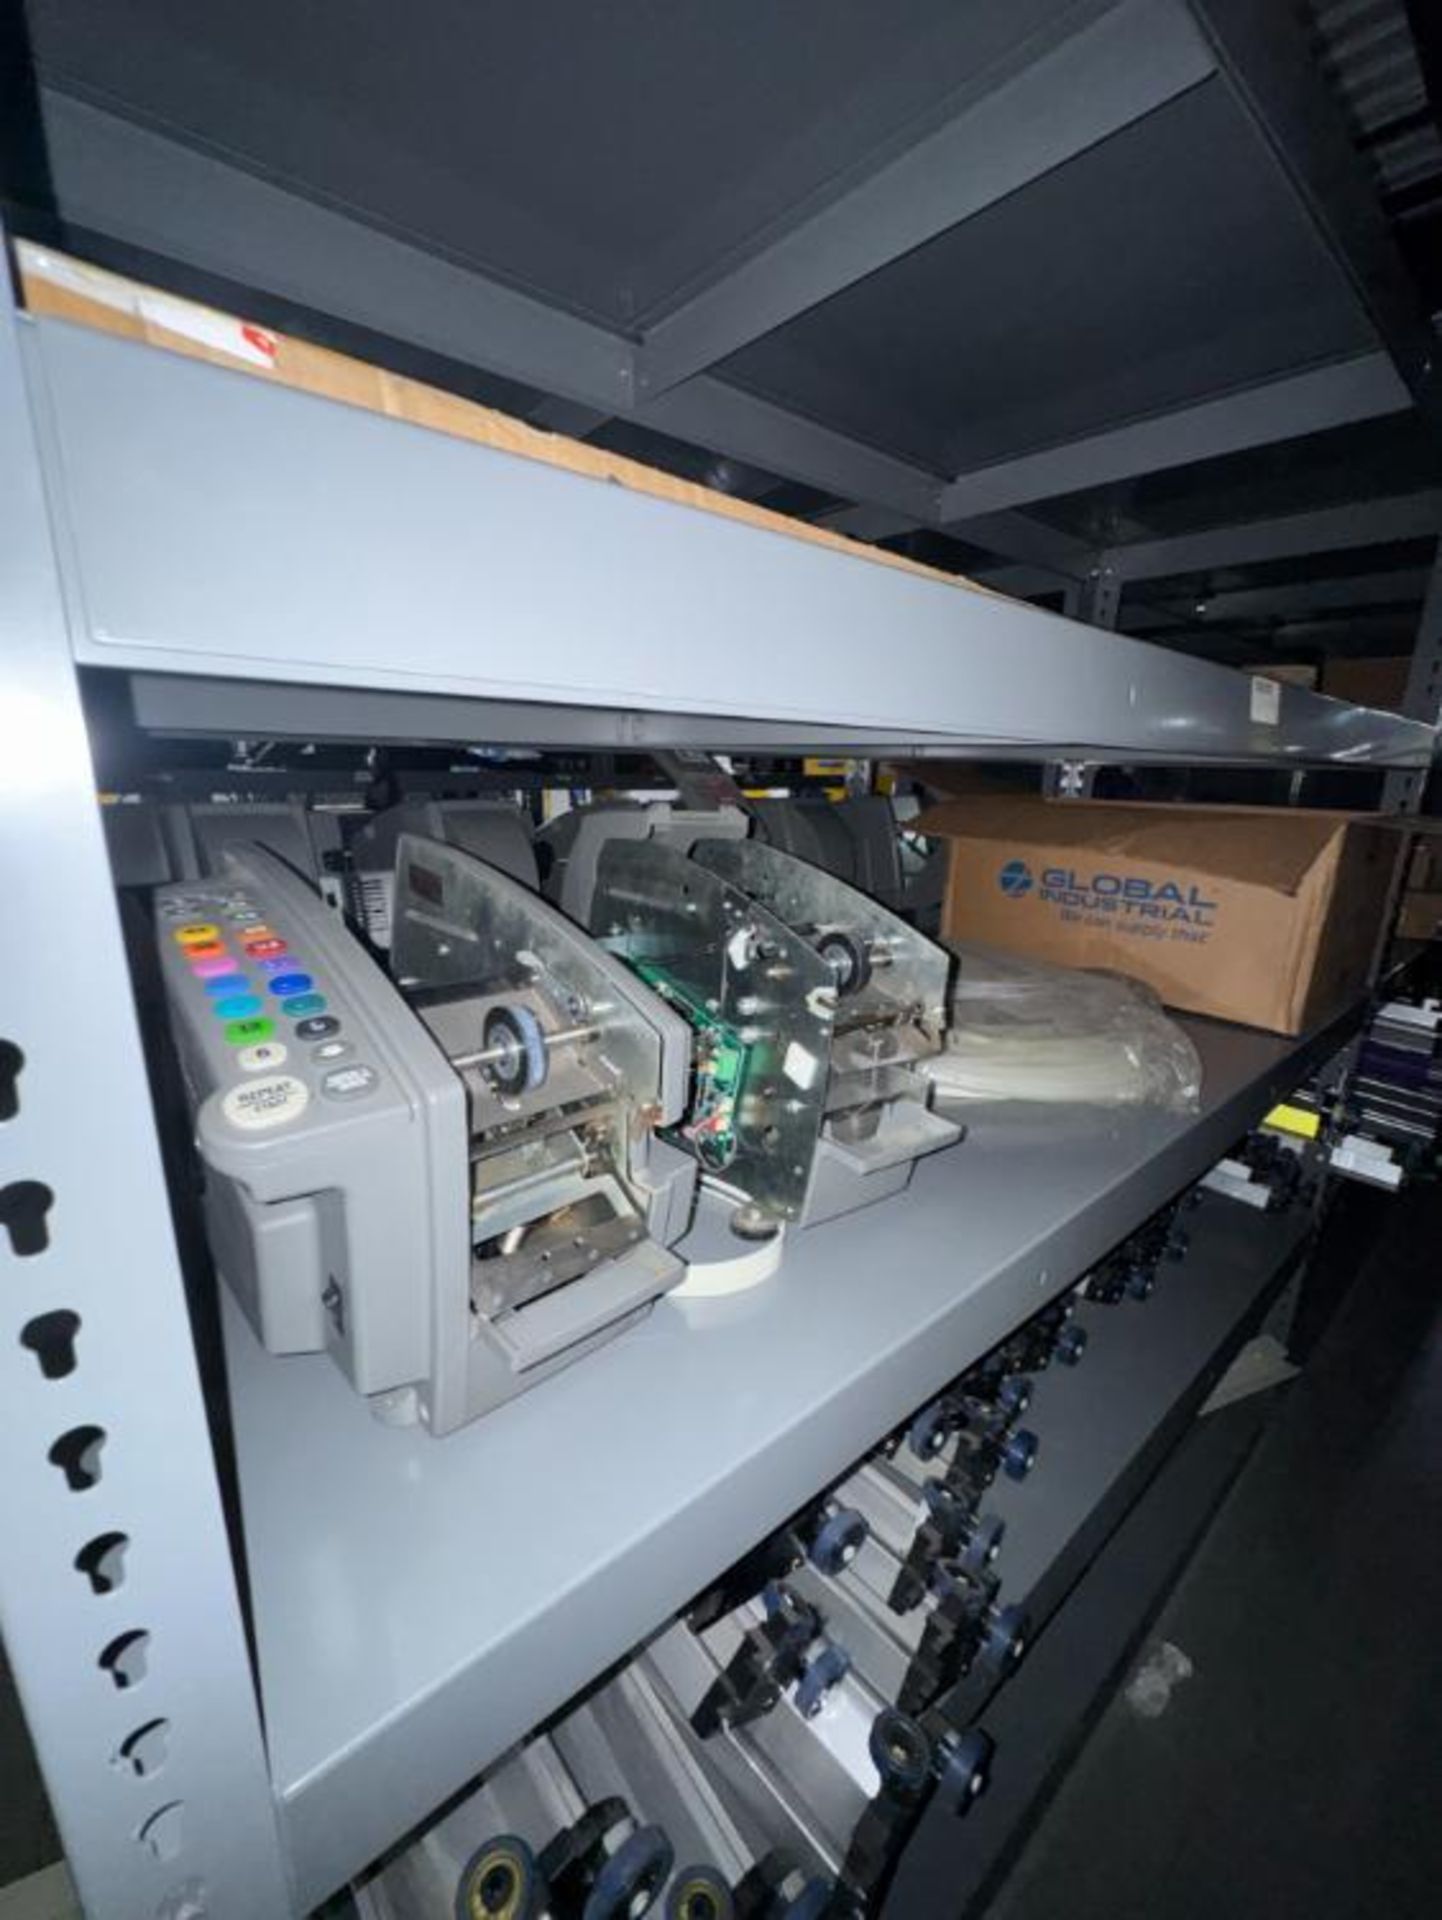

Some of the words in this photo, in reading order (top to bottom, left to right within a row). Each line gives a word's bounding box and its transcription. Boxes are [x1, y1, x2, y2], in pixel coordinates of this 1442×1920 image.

[1040, 888, 1214, 927] INDUSTRIAL
[1041, 868, 1218, 909] GLOBAL
[237, 1080, 291, 1103] REPEAT
